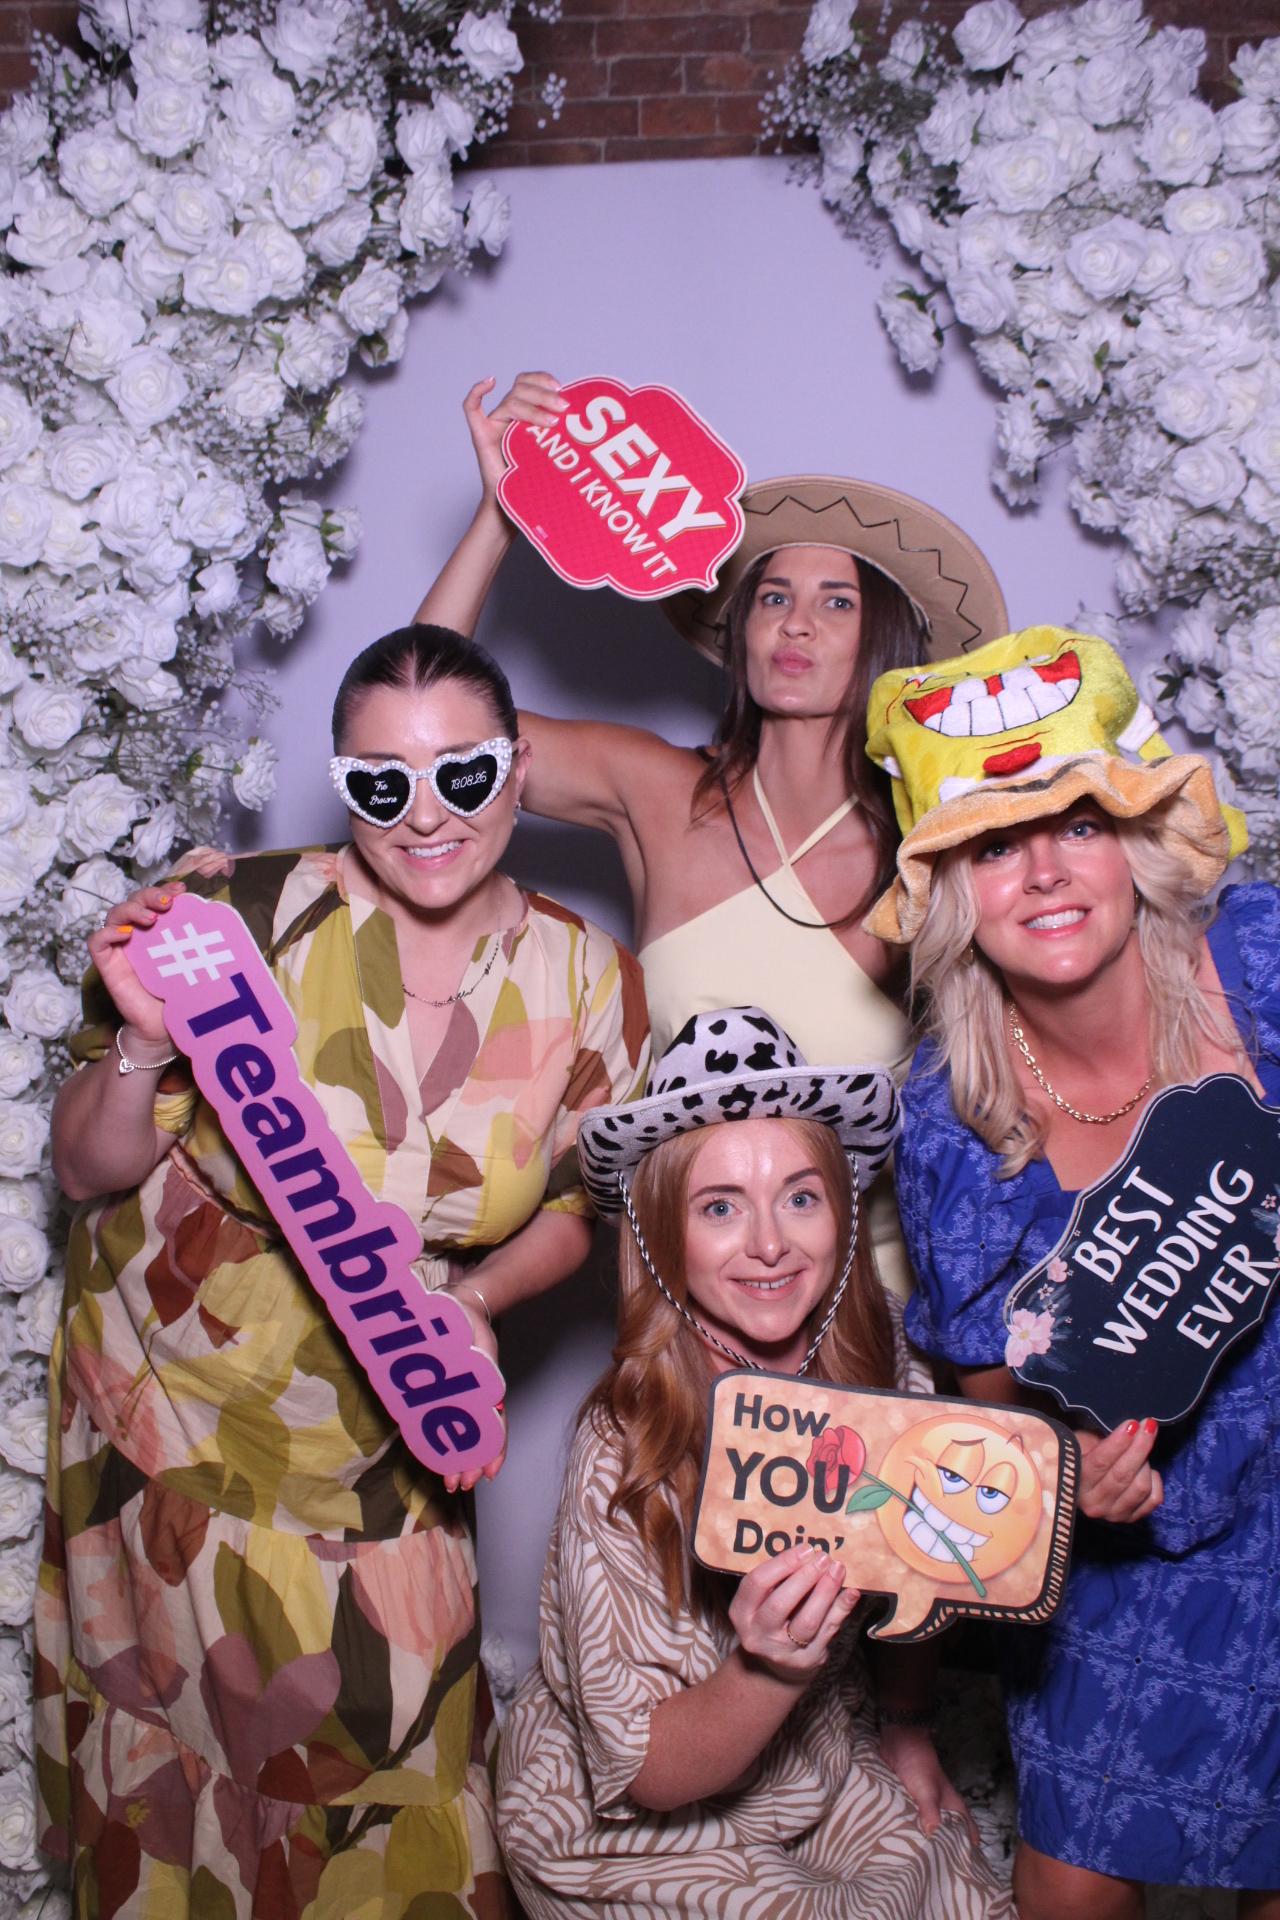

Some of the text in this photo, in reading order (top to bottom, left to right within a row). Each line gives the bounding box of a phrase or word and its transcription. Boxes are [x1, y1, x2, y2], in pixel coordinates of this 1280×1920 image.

[525, 425, 678, 579] AND I KNOW IT
[565, 395, 727, 542] SEXY
[146, 922, 482, 1456] #Teambride
[1072, 1165, 1175, 1283] BEST
[1092, 1160, 1254, 1354] WEDDING
[1176, 1243, 1279, 1350] EVER
[726, 1447, 850, 1514] YOU
[733, 1392, 831, 1437] How
